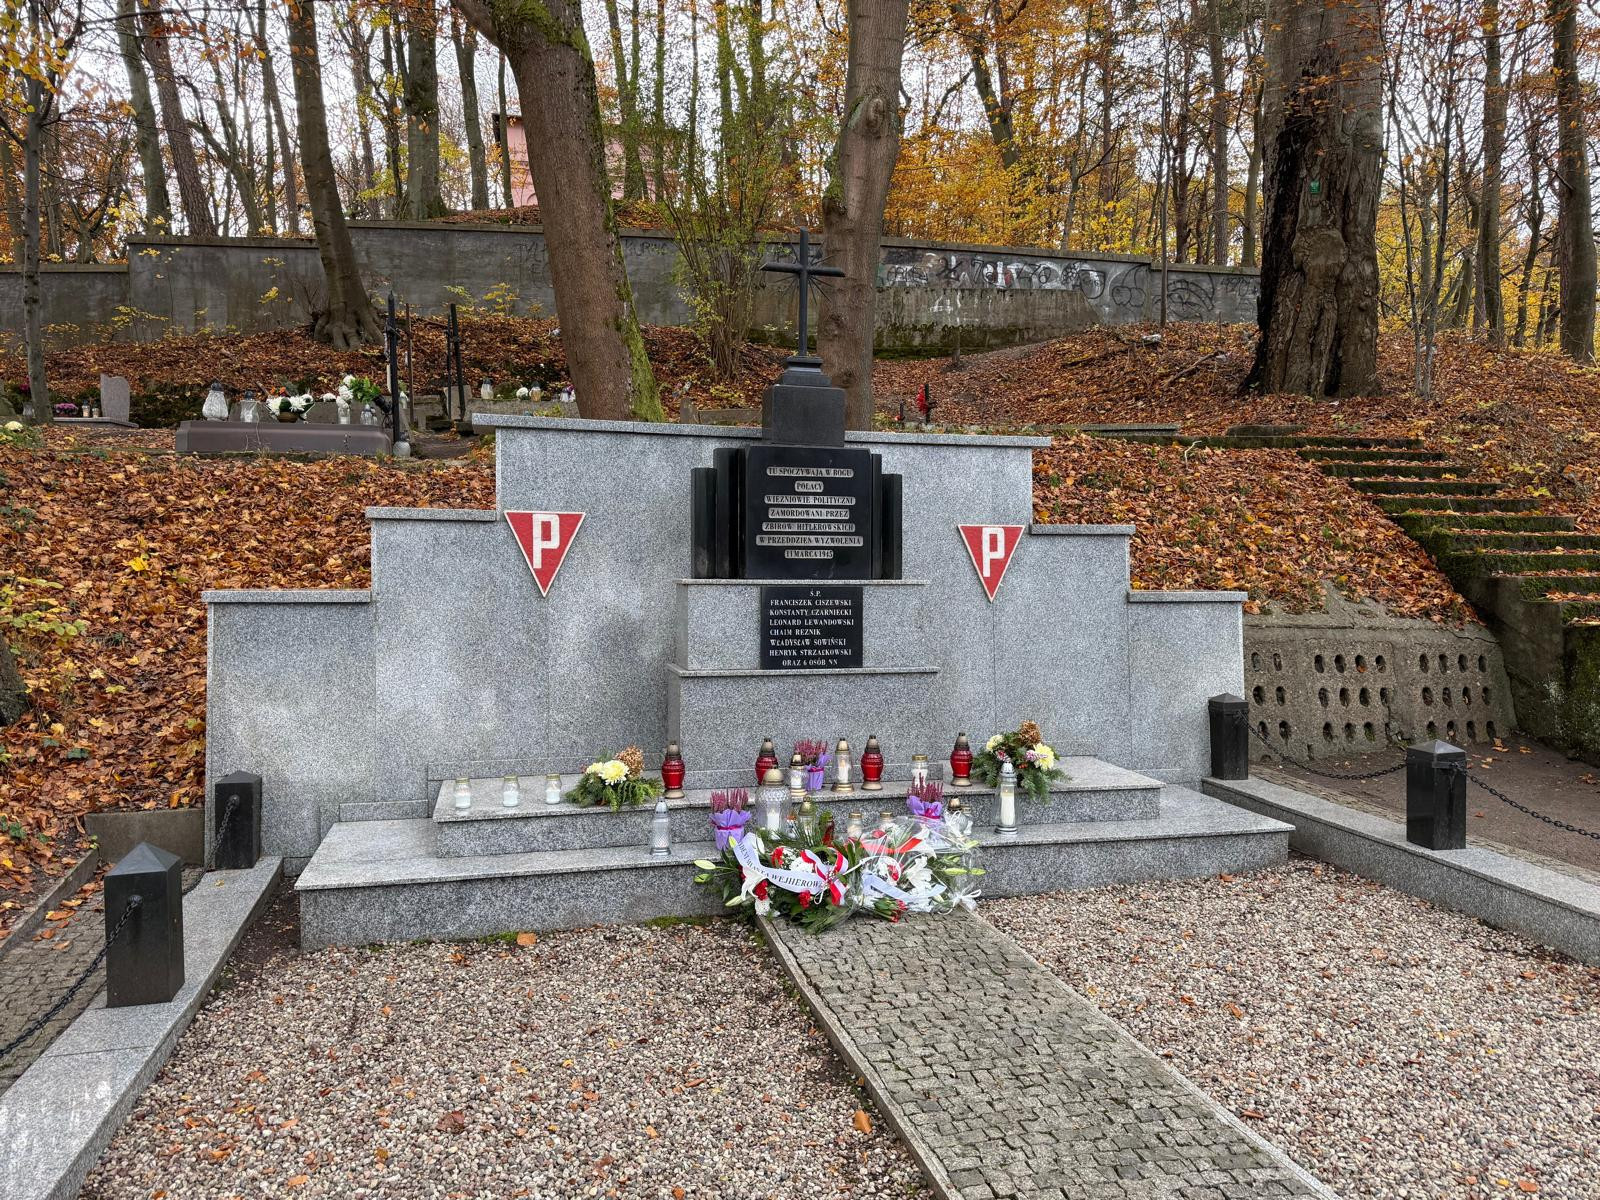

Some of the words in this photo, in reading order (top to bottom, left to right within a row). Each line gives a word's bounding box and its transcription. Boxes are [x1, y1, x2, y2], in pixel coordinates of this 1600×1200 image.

[796, 482, 823, 491] POLACY
[770, 508, 822, 517] ZAMORDOWANI
[826, 509, 849, 518] PRZEZ
[796, 523, 854, 531] HITLEROWSKICH
[532, 514, 560, 568] P
[814, 537, 861, 545] WYZWOLENIA
[982, 527, 1005, 577] P
[814, 637, 846, 646] SOWIŃSKI
